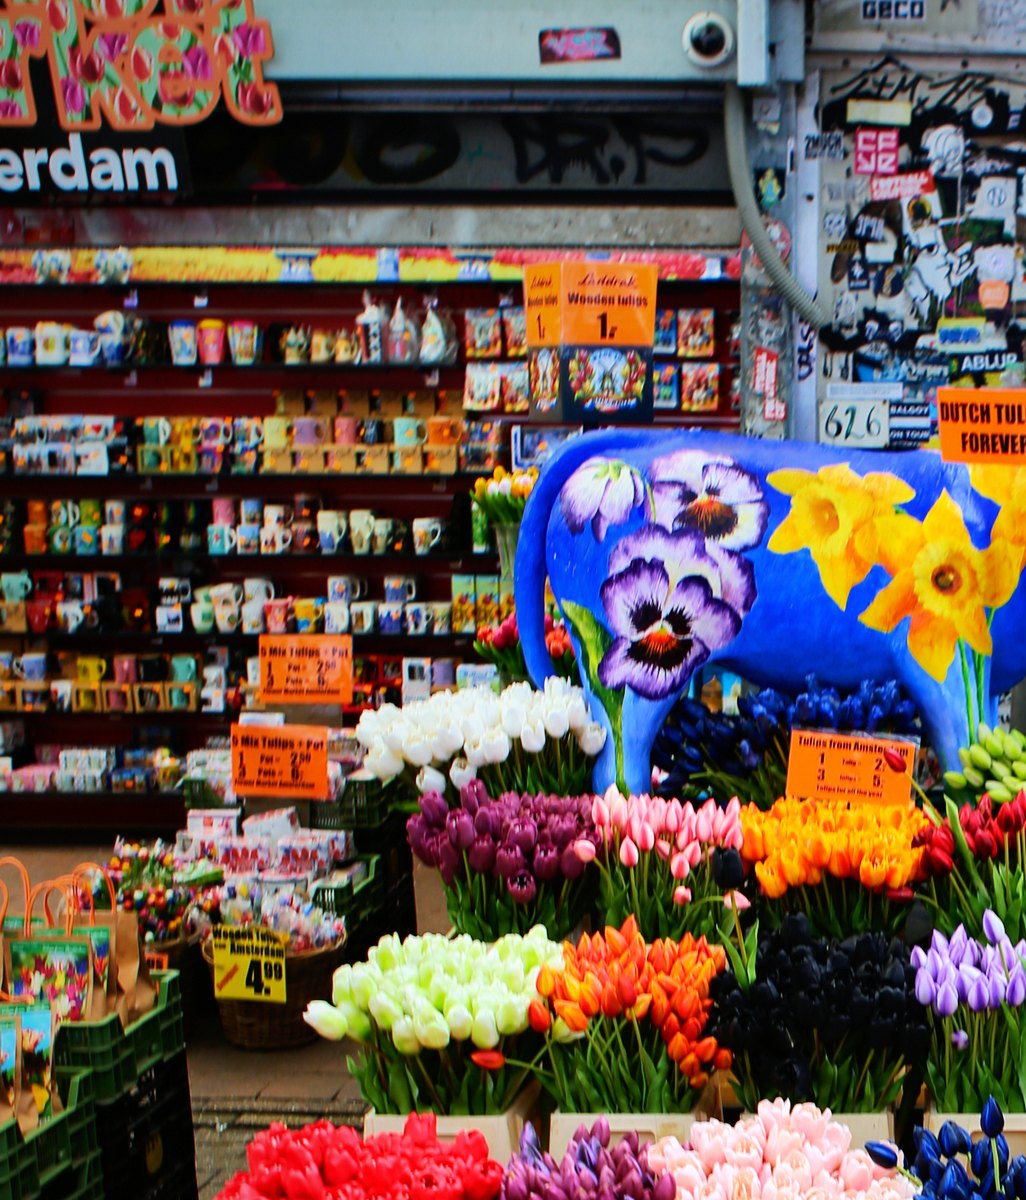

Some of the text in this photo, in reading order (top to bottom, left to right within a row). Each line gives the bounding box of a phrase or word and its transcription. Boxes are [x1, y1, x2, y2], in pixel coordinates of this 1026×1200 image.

[940, 402, 990, 423] DUTCH
[825, 405, 881, 440] 626
[269, 648, 286, 656] Mix
[290, 647, 320, 658] Tulips
[241, 736, 259, 747] Mix
[262, 735, 294, 750] Tulips
[799, 736, 851, 749] Tulips from
[820, 752, 825, 765] 1
[817, 769, 825, 781] 3
[816, 785, 836, 793] Tulips
[857, 787, 867, 796] the
[868, 790, 883, 798] year
[212, 926, 254, 941] Wooden
[230, 943, 284, 959] Amsterdam
